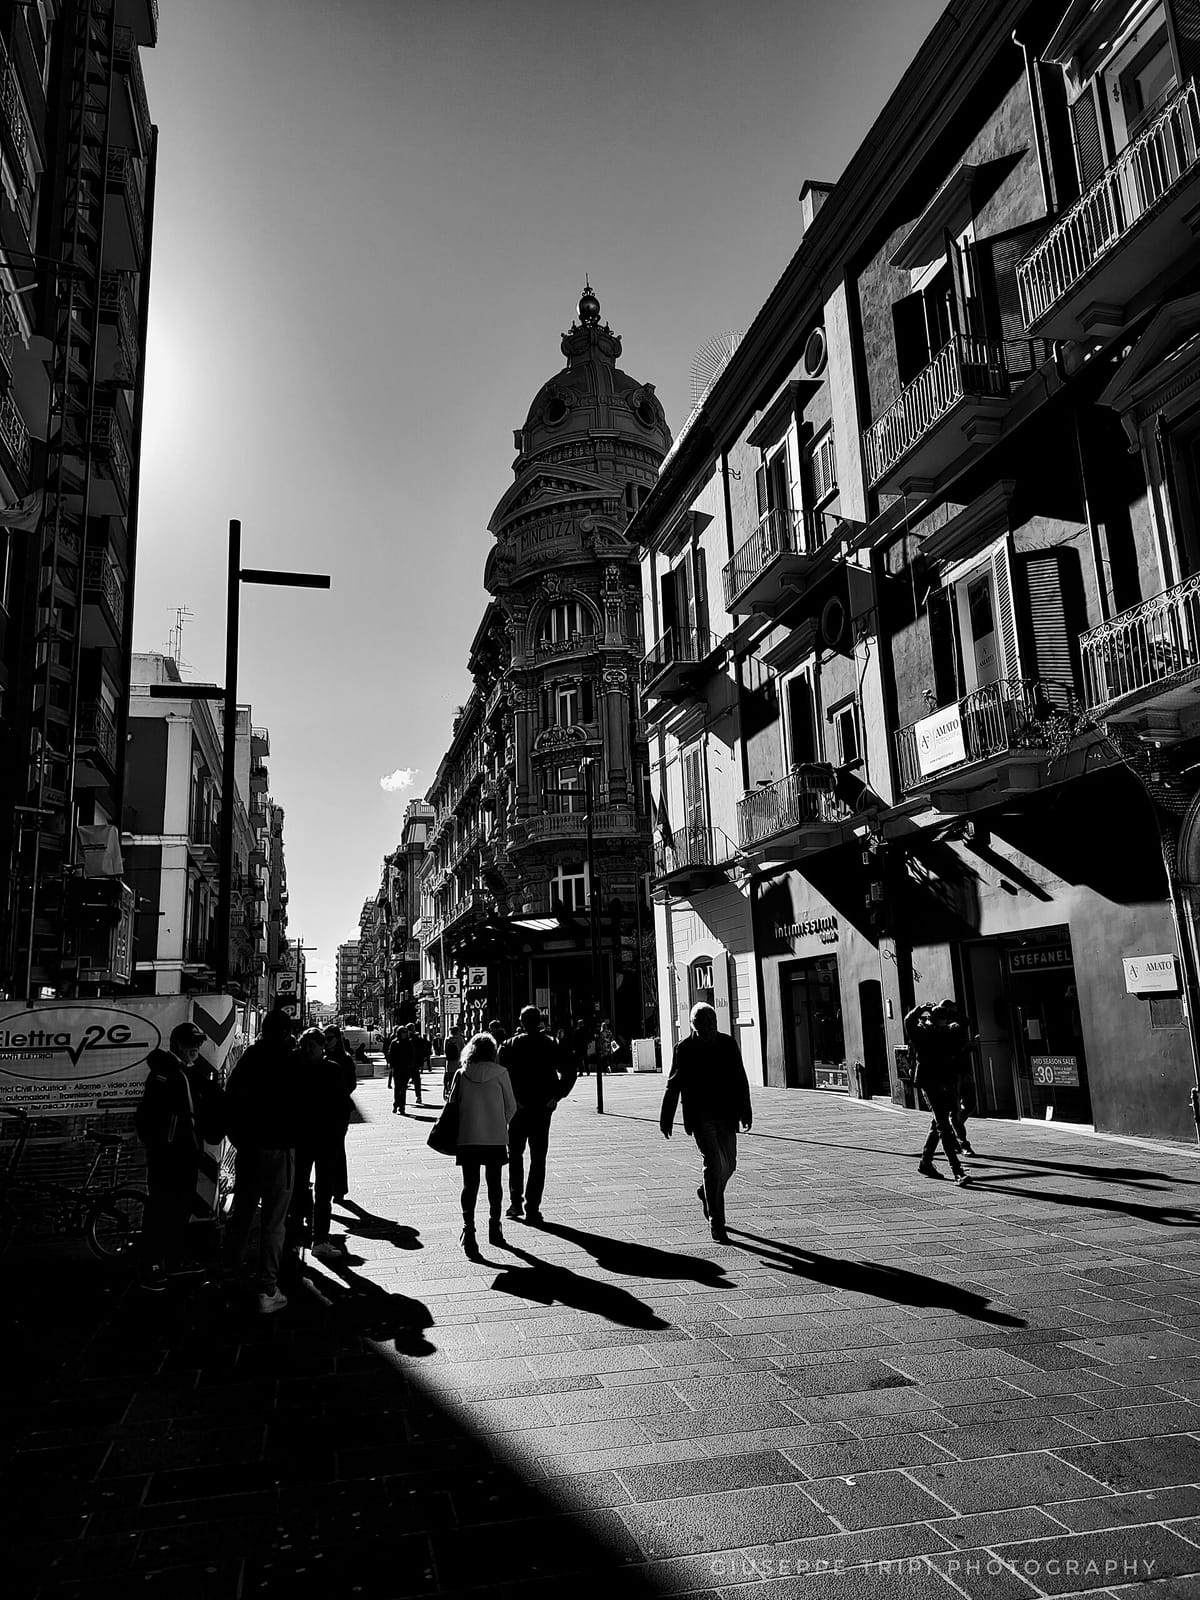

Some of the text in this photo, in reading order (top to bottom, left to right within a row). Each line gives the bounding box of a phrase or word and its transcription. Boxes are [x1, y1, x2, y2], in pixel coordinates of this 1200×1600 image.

[521, 519, 576, 552] MINCUZZI
[935, 719, 959, 739] AMATO
[774, 916, 838, 938] intimissimi
[1014, 950, 1071, 966] STEFANEL
[1146, 961, 1172, 971] AMATO
[85, 1024, 133, 1050] 2G
